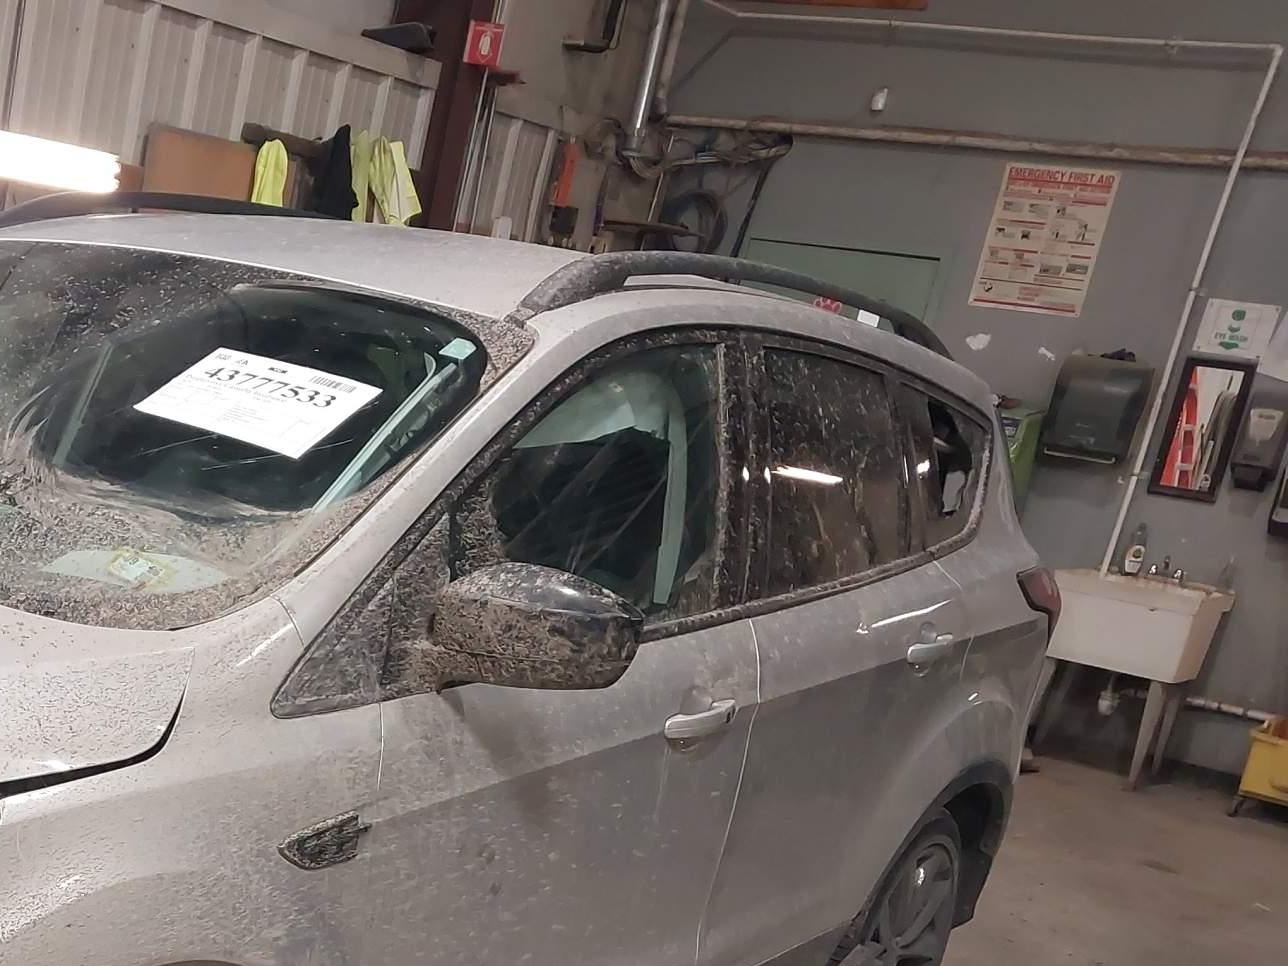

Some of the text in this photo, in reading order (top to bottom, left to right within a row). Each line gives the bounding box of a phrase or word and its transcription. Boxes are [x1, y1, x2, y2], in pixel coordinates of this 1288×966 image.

[1008, 166, 1116, 185] EMERGENCY FIRST AID
[202, 366, 337, 408] 43777533
